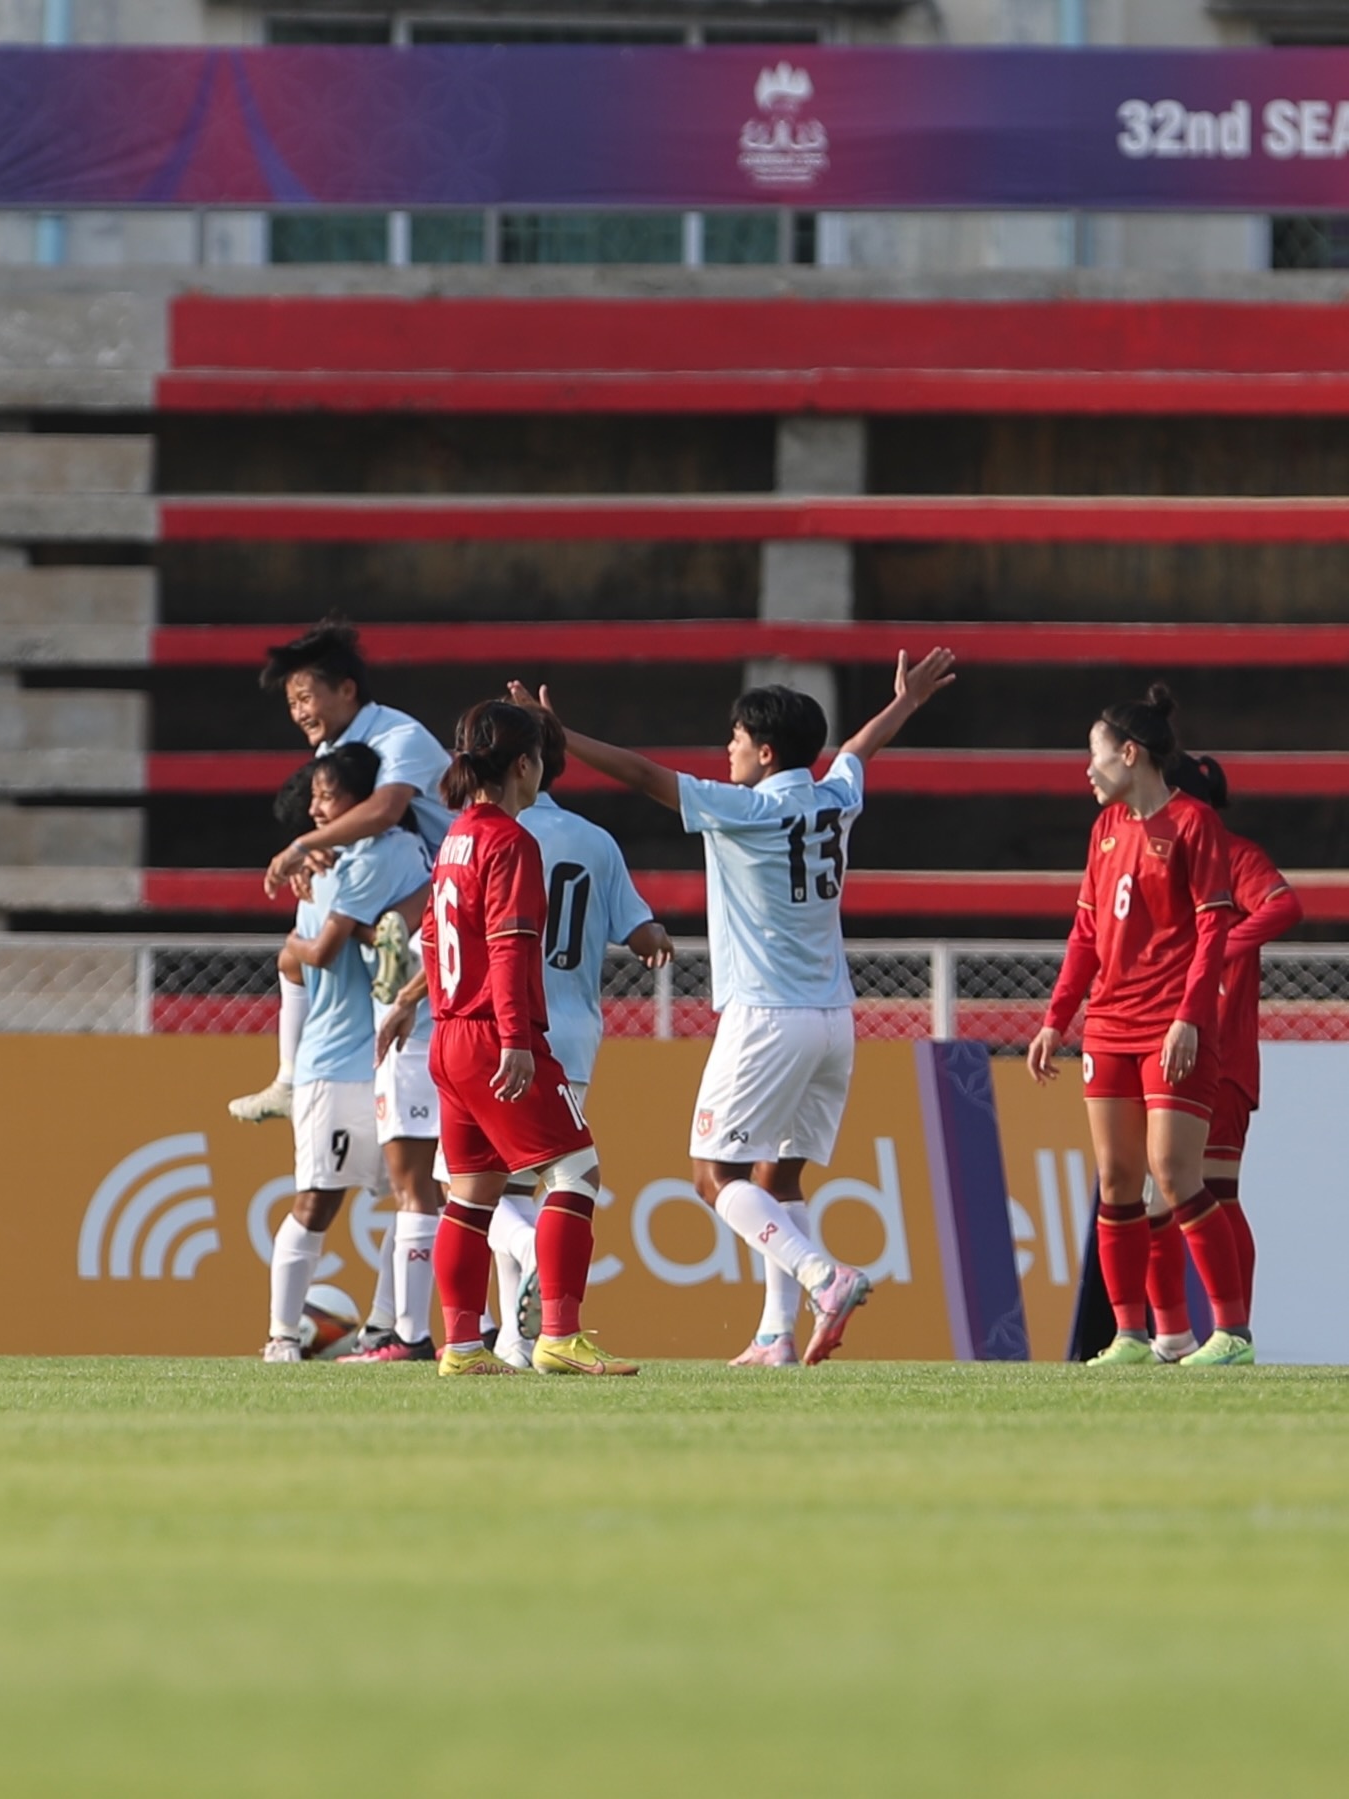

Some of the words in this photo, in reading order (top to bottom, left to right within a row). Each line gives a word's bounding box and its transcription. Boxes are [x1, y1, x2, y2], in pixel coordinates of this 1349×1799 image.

[1115, 99, 1251, 159] 32nd
[781, 807, 843, 903] 13
[1113, 873, 1133, 921] 6
[331, 1129, 350, 1173] 9
